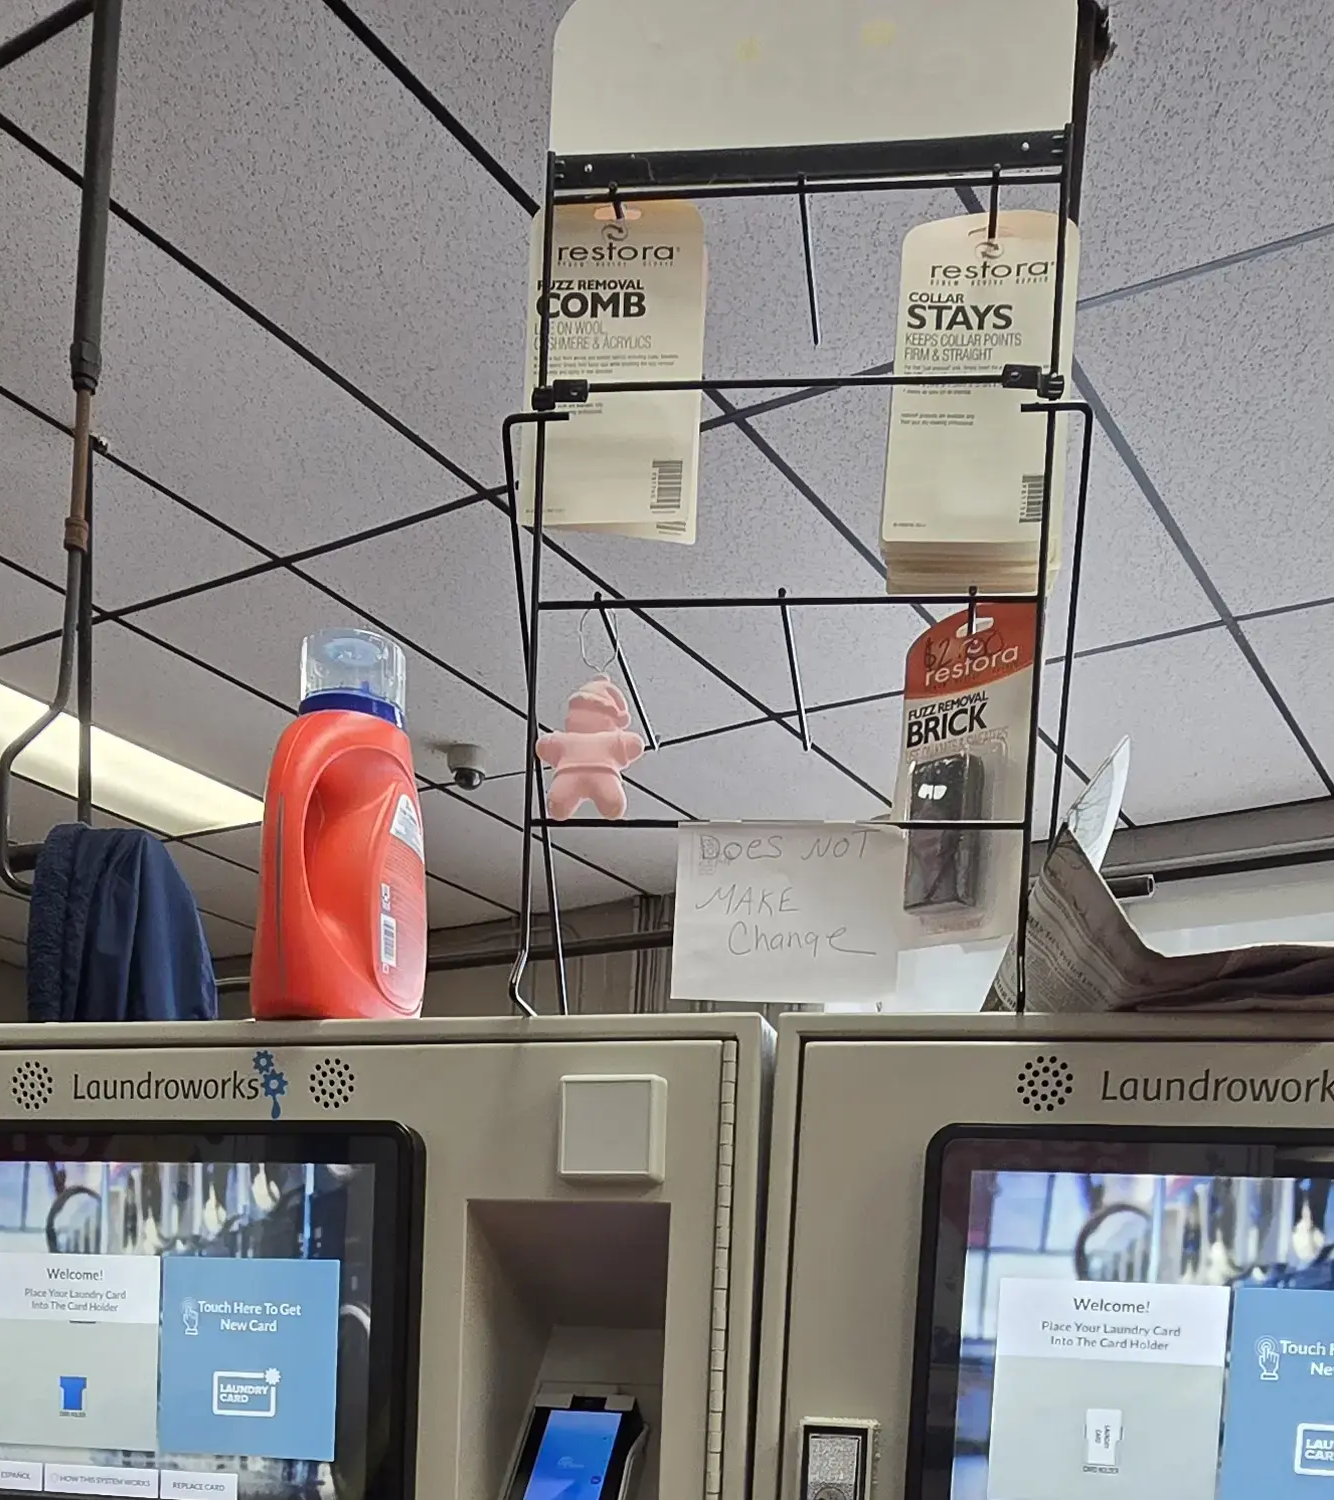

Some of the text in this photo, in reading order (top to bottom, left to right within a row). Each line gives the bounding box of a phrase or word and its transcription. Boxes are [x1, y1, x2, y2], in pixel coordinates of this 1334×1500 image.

[558, 242, 674, 261] restora
[931, 261, 1049, 279] restora
[578, 279, 644, 291] REMOVAL
[536, 292, 646, 318] COMB
[909, 292, 964, 304] COLLAR
[907, 304, 1013, 330] STAYS
[534, 335, 651, 350] CSHMERE & ACRYLICS
[905, 333, 1022, 347] KEEPS COLLAR POINTS
[904, 347, 993, 361] FIRM & STRAIGHT
[925, 646, 1018, 686] restora
[908, 690, 988, 721] FUZZ REMOVAL
[907, 702, 987, 748] BRICK
[801, 829, 883, 862] NOT
[695, 884, 802, 916] MAKE
[728, 921, 876, 958] Change
[73, 1071, 260, 1100] Laundroworks
[46, 1268, 104, 1281] Welcome!
[24, 1288, 126, 1300] Place Your Laundry Card
[31, 1301, 119, 1312] Into The Card Holder
[198, 1300, 301, 1316] Touch Here To Get
[1073, 1297, 1150, 1313] Welcome!
[220, 1318, 277, 1332] New Card
[1041, 1321, 1181, 1337] Place Your Laundry Card
[1050, 1336, 1169, 1351] Into The Card Holder
[1279, 1339, 1326, 1356] Touch
[220, 1383, 269, 1395] LAUNDRY
[220, 1394, 248, 1403] CARD
[172, 1481, 225, 1492] REPLACE CARD
